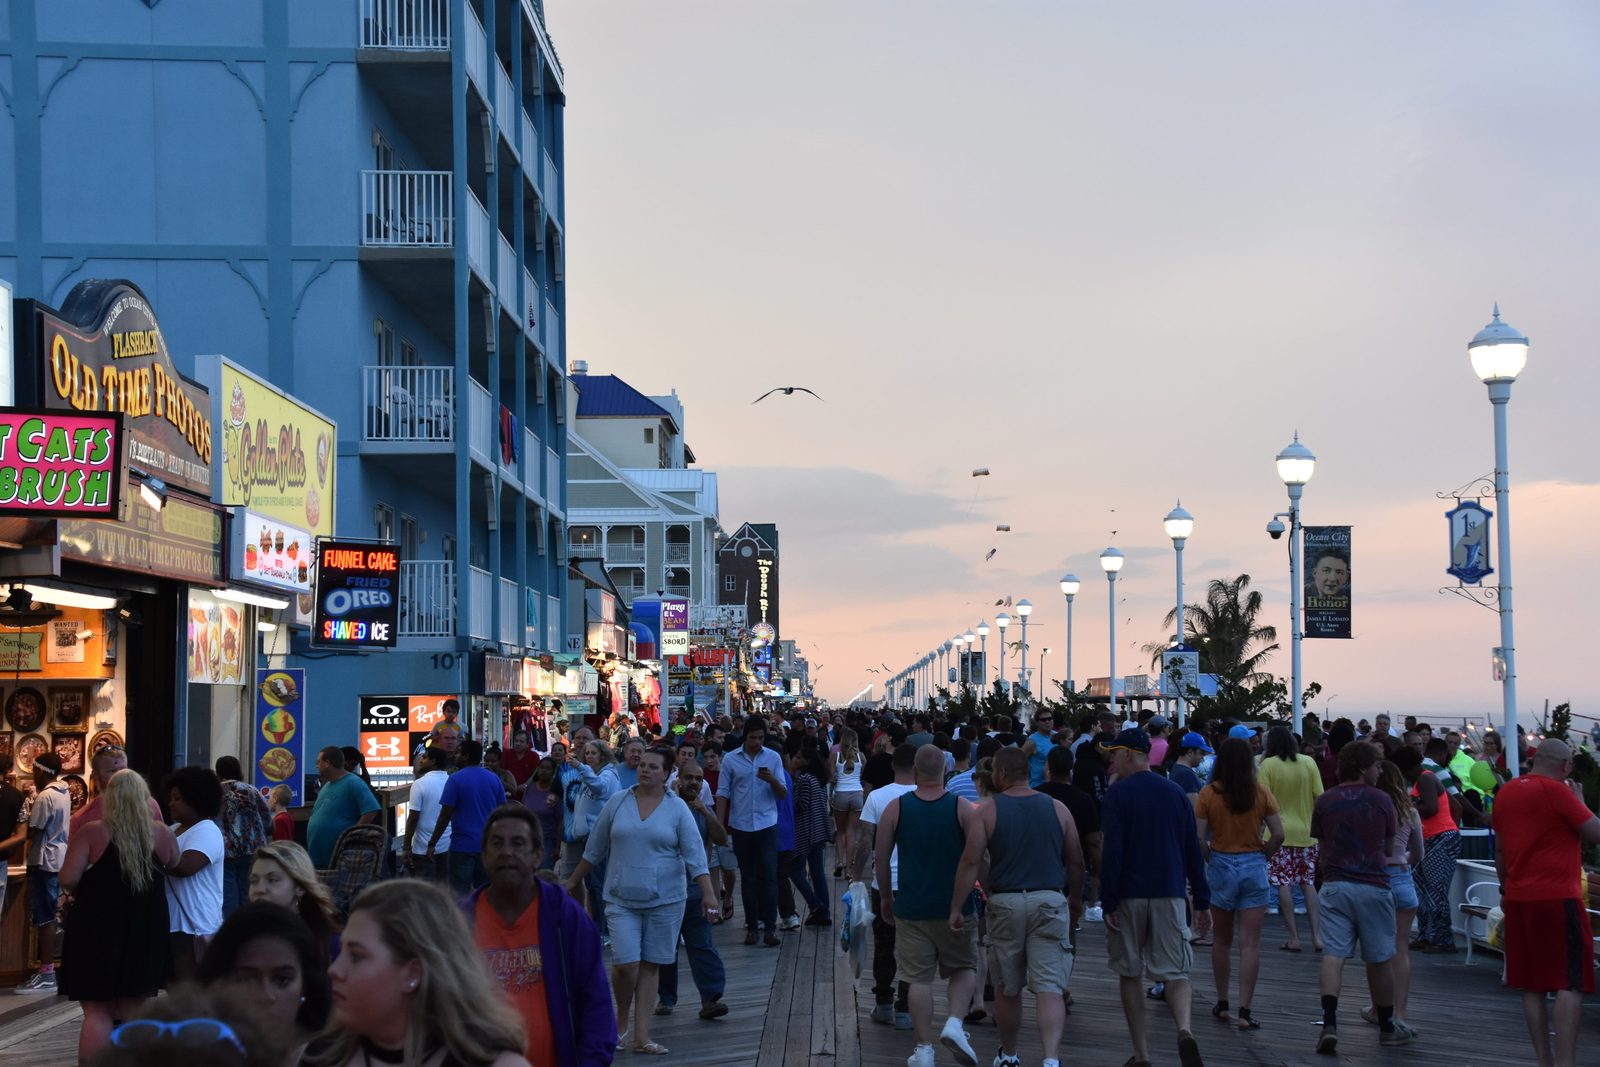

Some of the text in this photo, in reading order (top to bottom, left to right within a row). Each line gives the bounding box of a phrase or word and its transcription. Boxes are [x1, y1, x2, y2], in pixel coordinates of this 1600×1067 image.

[103, 302, 123, 336] WELCOME
[122, 297, 129, 309] TO
[128, 296, 143, 311] OCEAN
[112, 330, 159, 360] FLASHBACK
[51, 334, 98, 411] OLD
[102, 364, 150, 418] TIME
[152, 362, 211, 465] PHOTOS
[17, 418, 112, 465] CATS
[241, 418, 306, 507] Golden Plate
[0, 466, 110, 507] BRUSH
[1306, 531, 1348, 544] Ocean City
[1461, 513, 1476, 537] 1st
[96, 528, 220, 576] WWW.OLDTIMEPHOTOS.COM
[324, 550, 397, 570] FUNNEL CAKE
[346, 576, 390, 588] FRIED
[758, 566, 770, 597] Dough
[326, 590, 390, 615] OREO
[662, 602, 685, 613] Plaza
[1307, 595, 1349, 608] Honor
[324, 620, 390, 640] SHAVED ICE
[362, 717, 408, 725] OAKLEY
[411, 699, 446, 724] Ray-B
